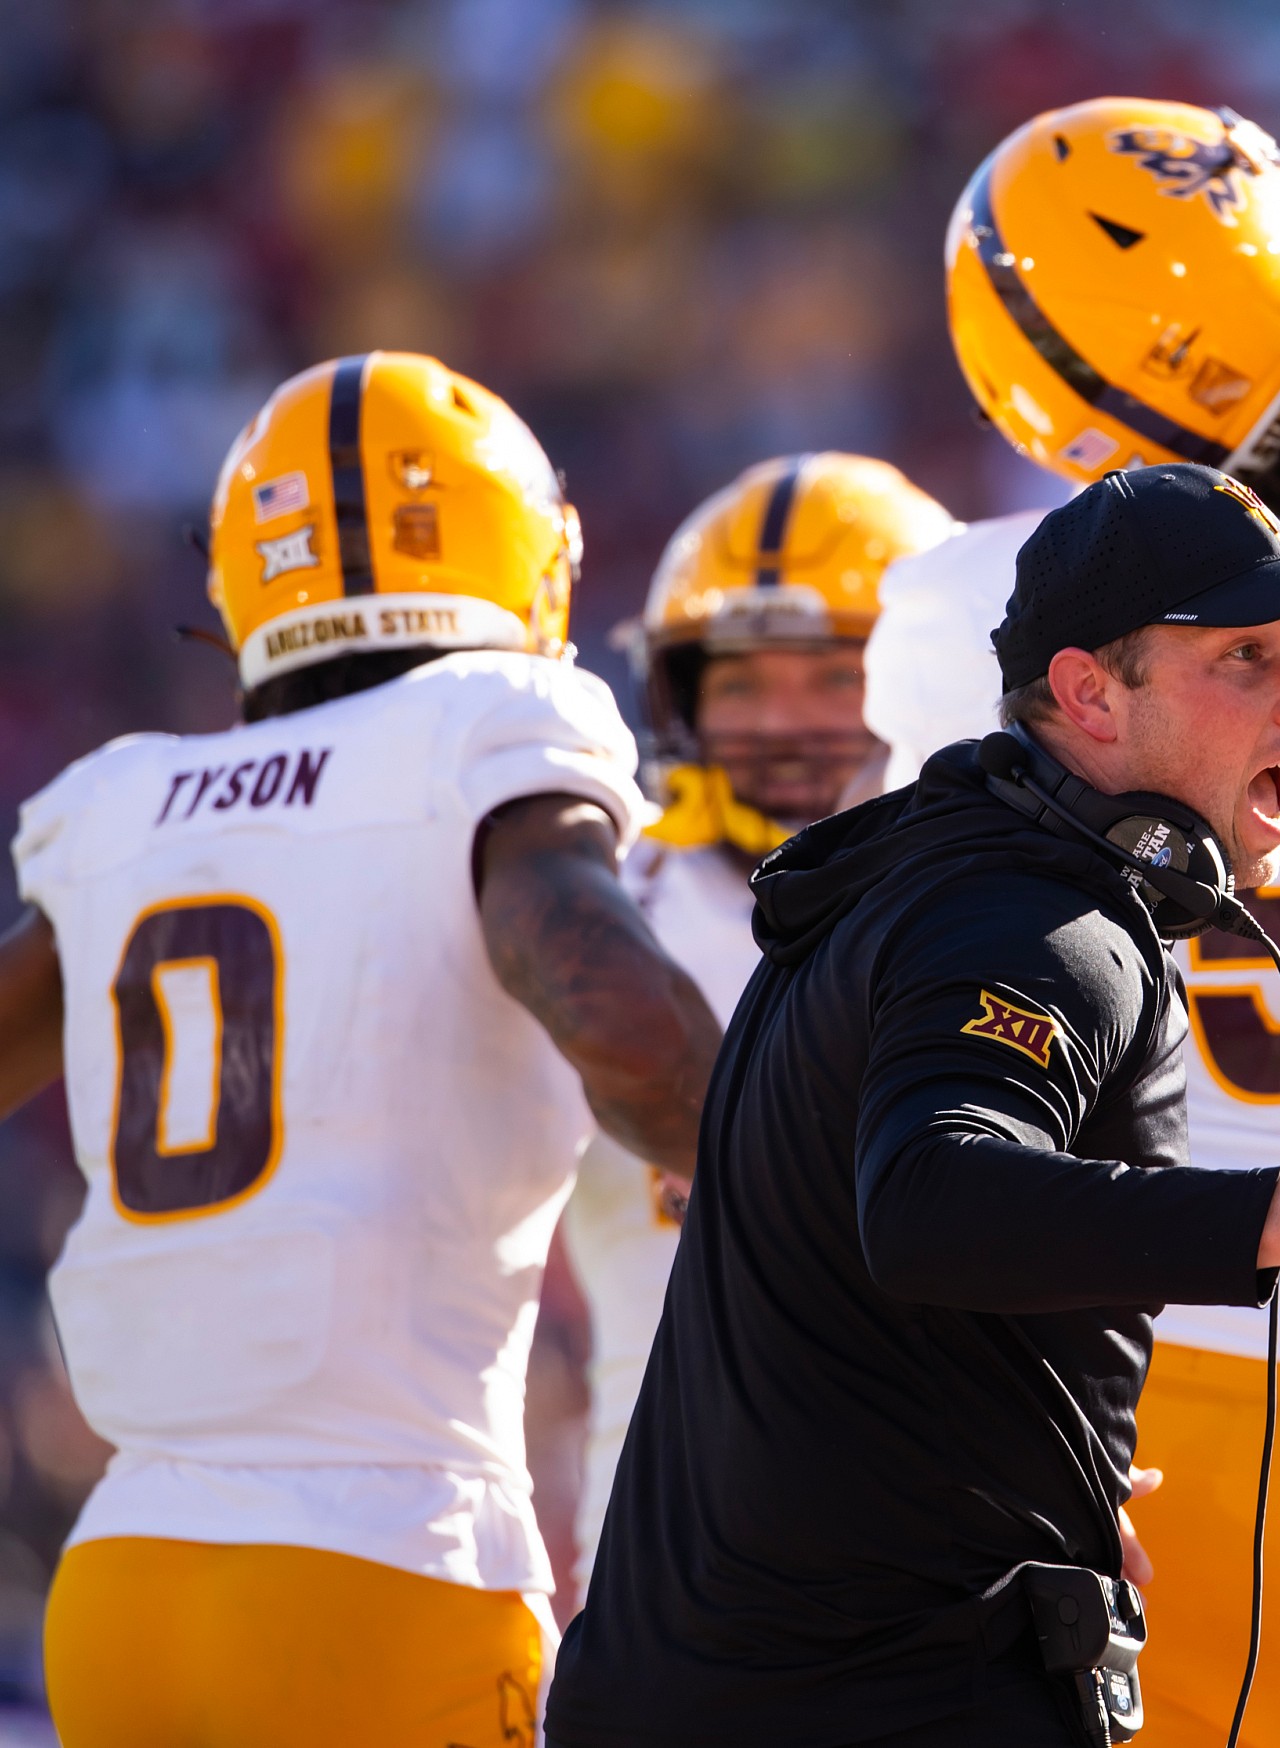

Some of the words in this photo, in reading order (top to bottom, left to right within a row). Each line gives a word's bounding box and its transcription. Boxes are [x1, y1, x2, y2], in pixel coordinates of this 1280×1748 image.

[265, 611, 368, 661] ARIZONA
[154, 747, 332, 828] TYSON
[110, 893, 286, 1226] 0
